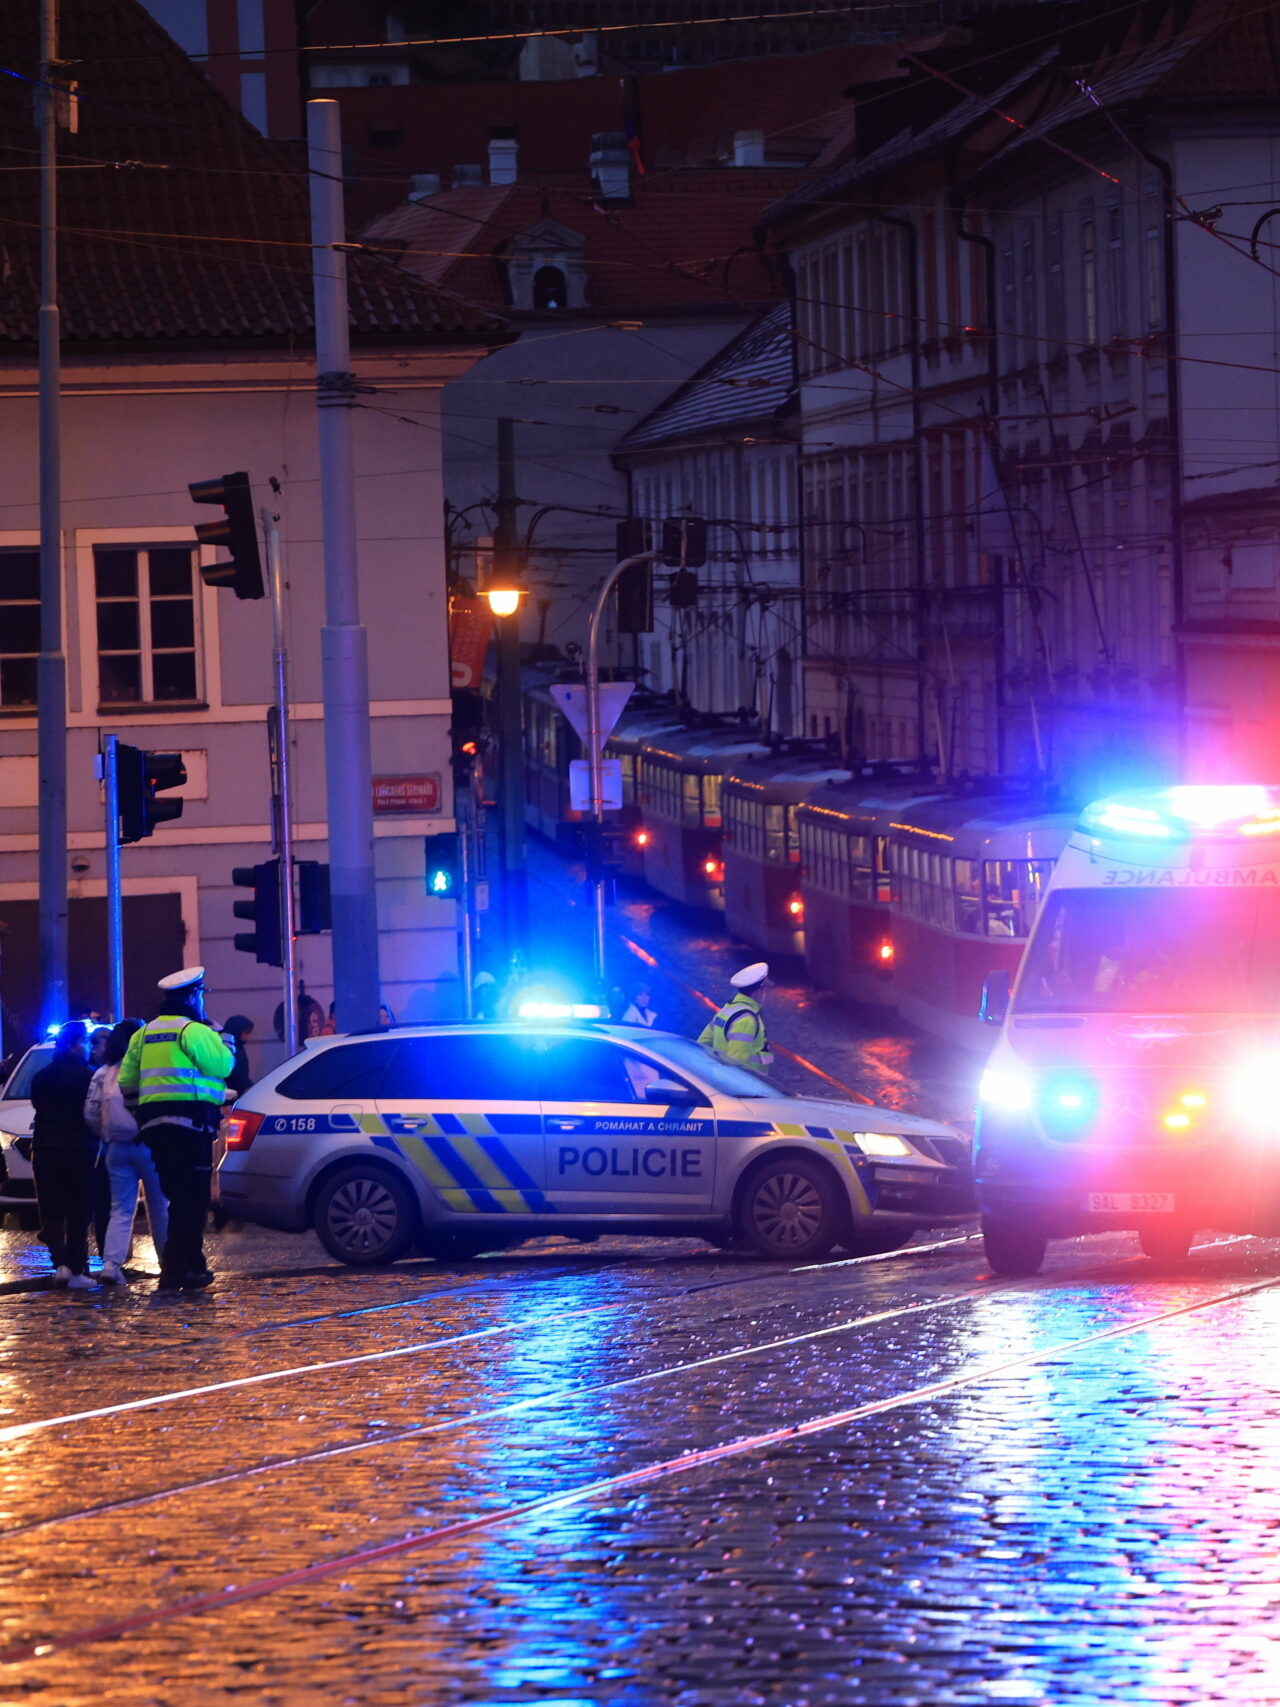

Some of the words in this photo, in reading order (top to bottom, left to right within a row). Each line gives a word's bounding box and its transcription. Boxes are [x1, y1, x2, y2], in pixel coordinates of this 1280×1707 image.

[290, 1118, 316, 1131] 158
[595, 1120, 645, 1130] POMÁHAT
[647, 1122, 655, 1130] A
[657, 1121, 704, 1132] CHRÁNIT
[558, 1146, 702, 1177] POLICIE
